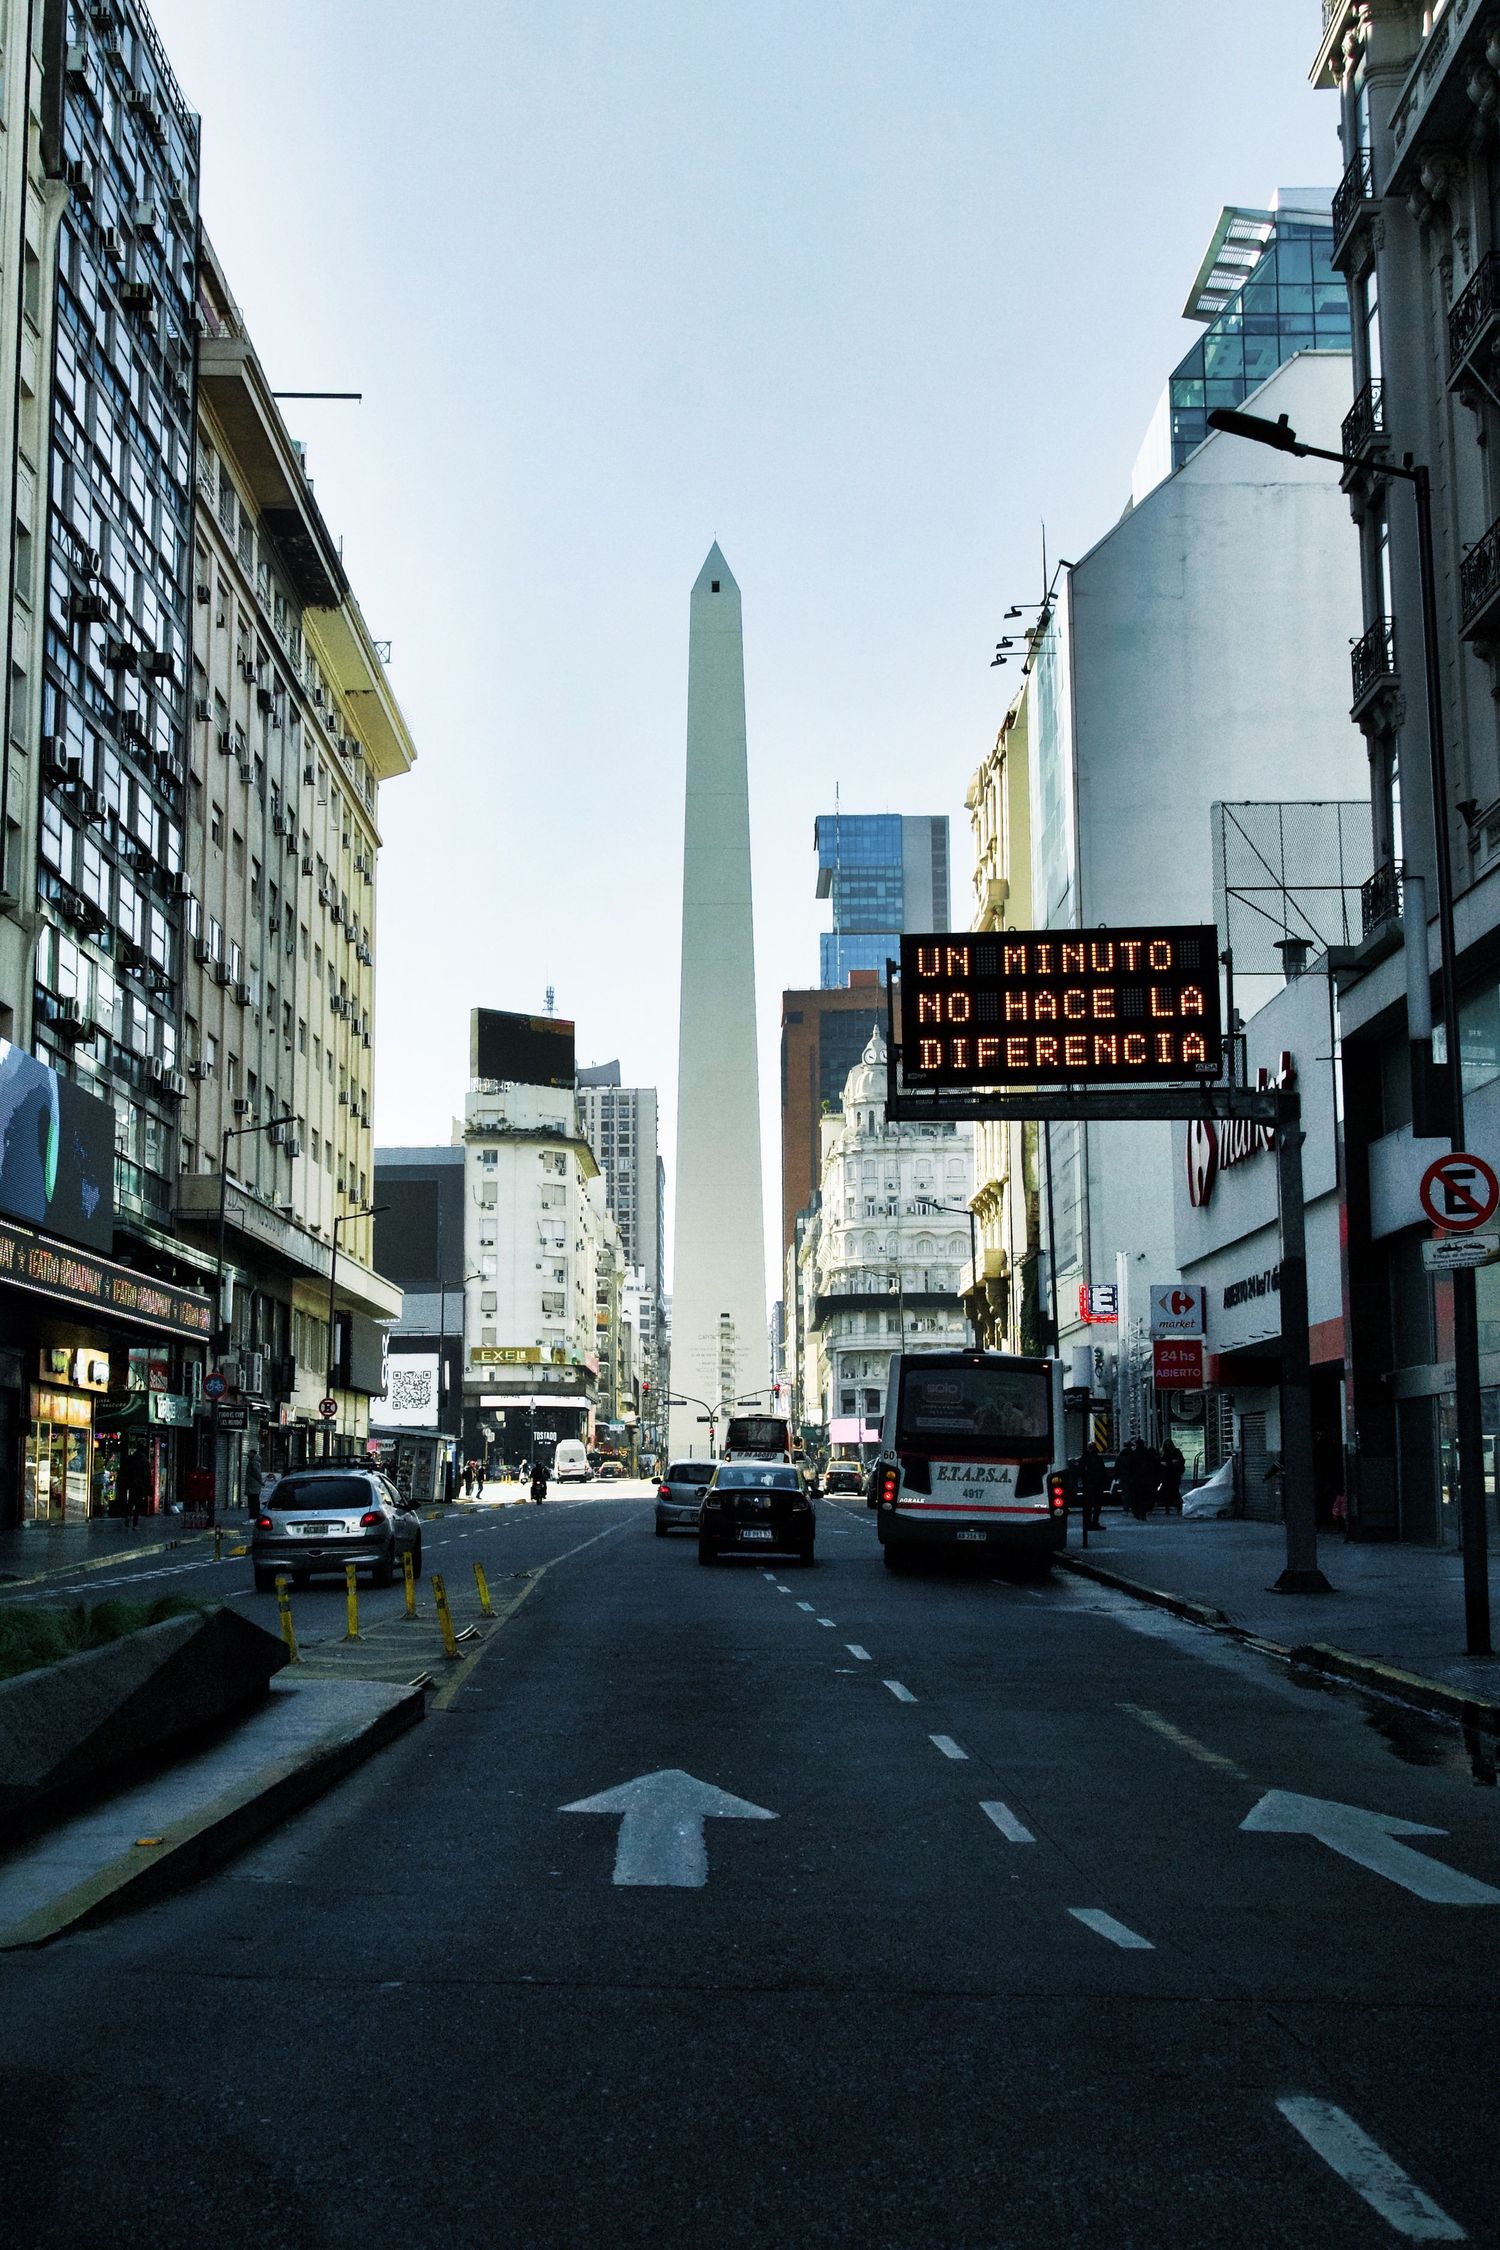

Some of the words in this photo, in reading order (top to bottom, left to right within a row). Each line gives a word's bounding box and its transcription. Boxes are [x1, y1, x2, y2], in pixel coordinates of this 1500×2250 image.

[918, 947, 968, 977] UN
[1004, 941, 1172, 975] MINUTO
[919, 992, 970, 1023] NO
[1005, 988, 1115, 1021] HACE
[1151, 985, 1203, 1017] LA
[919, 1032, 1206, 1070] DIFERENCIA
[1444, 1169, 1475, 1214] E
[1159, 1320, 1195, 1328] market
[1160, 1351, 1178, 1361] 24
[1180, 1350, 1196, 1361] hs
[1156, 1368, 1201, 1377] ABIERTO
[533, 1431, 557, 1441] TOSTADO
[883, 1451, 895, 1460] 60
[937, 1466, 1012, 1483] E.T.A.P.S.A.
[963, 1488, 984, 1499] 4917
